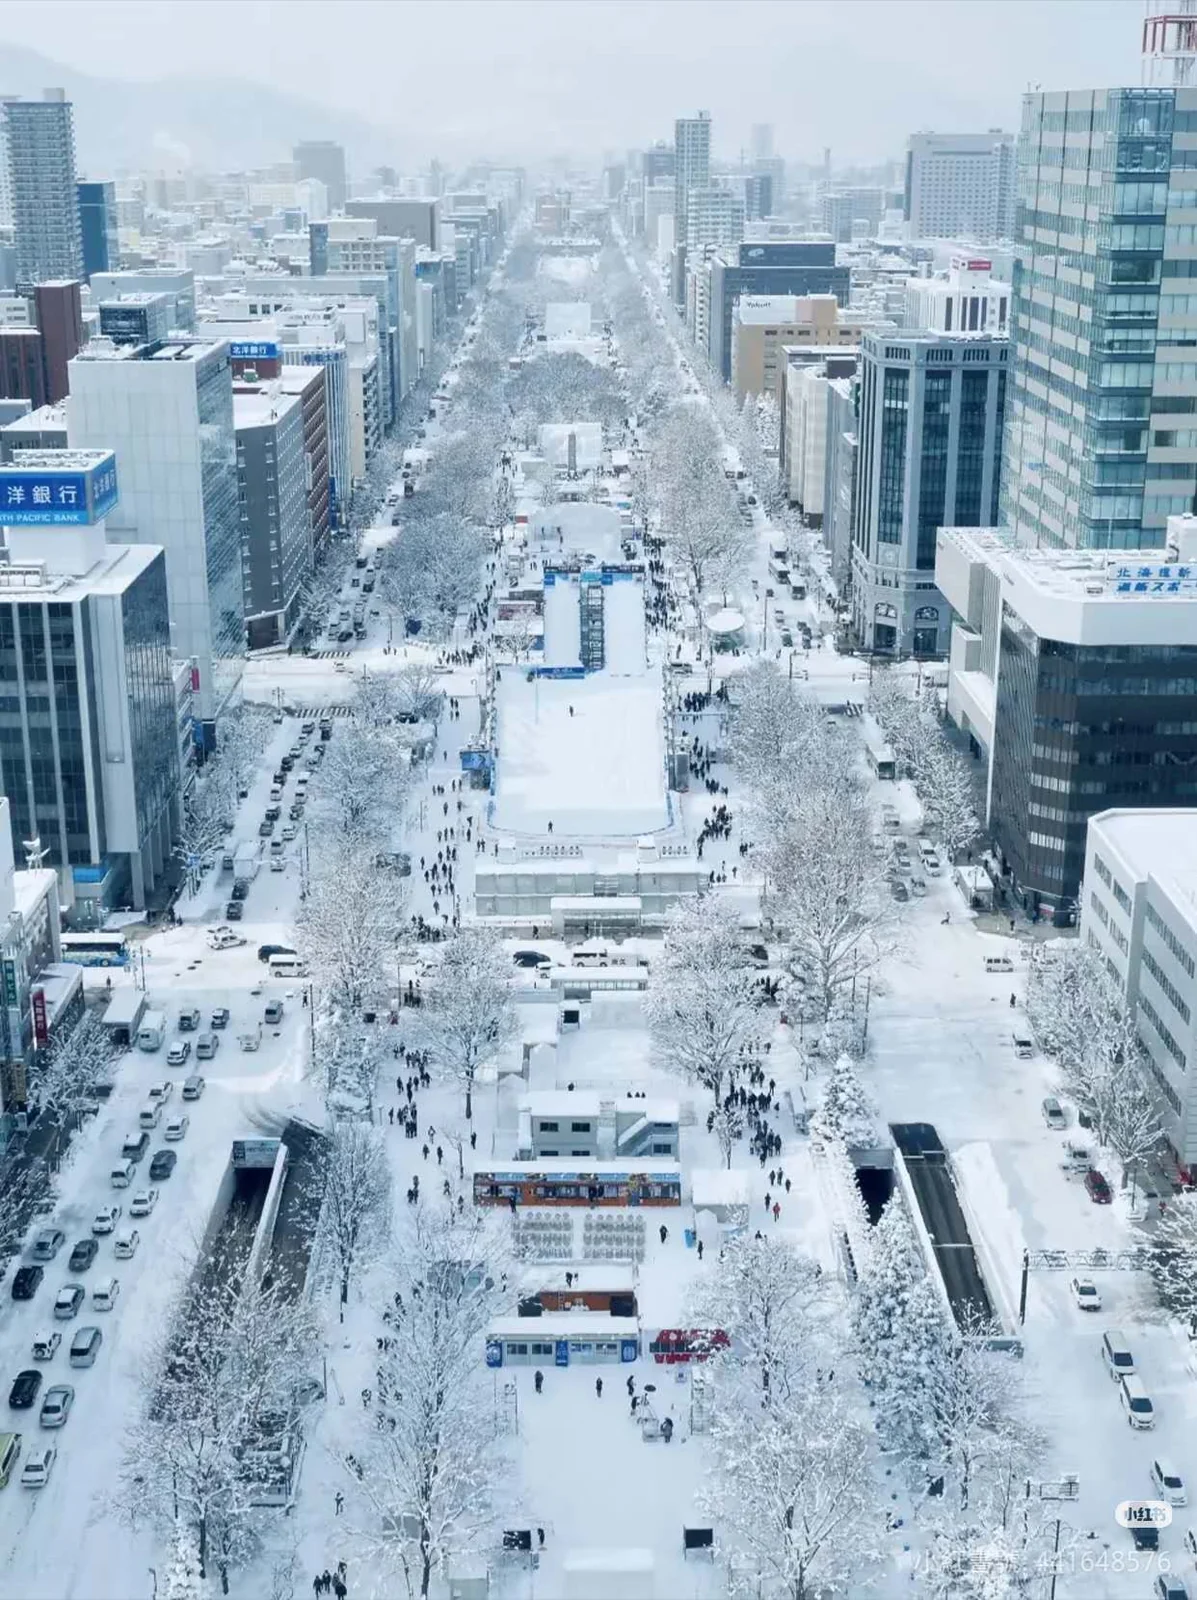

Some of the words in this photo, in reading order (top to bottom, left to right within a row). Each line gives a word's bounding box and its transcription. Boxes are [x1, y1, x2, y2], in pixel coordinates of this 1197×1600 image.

[8, 485, 77, 504] 洋銀行
[17, 514, 50, 522] PACIFIC
[54, 514, 79, 522] BANK
